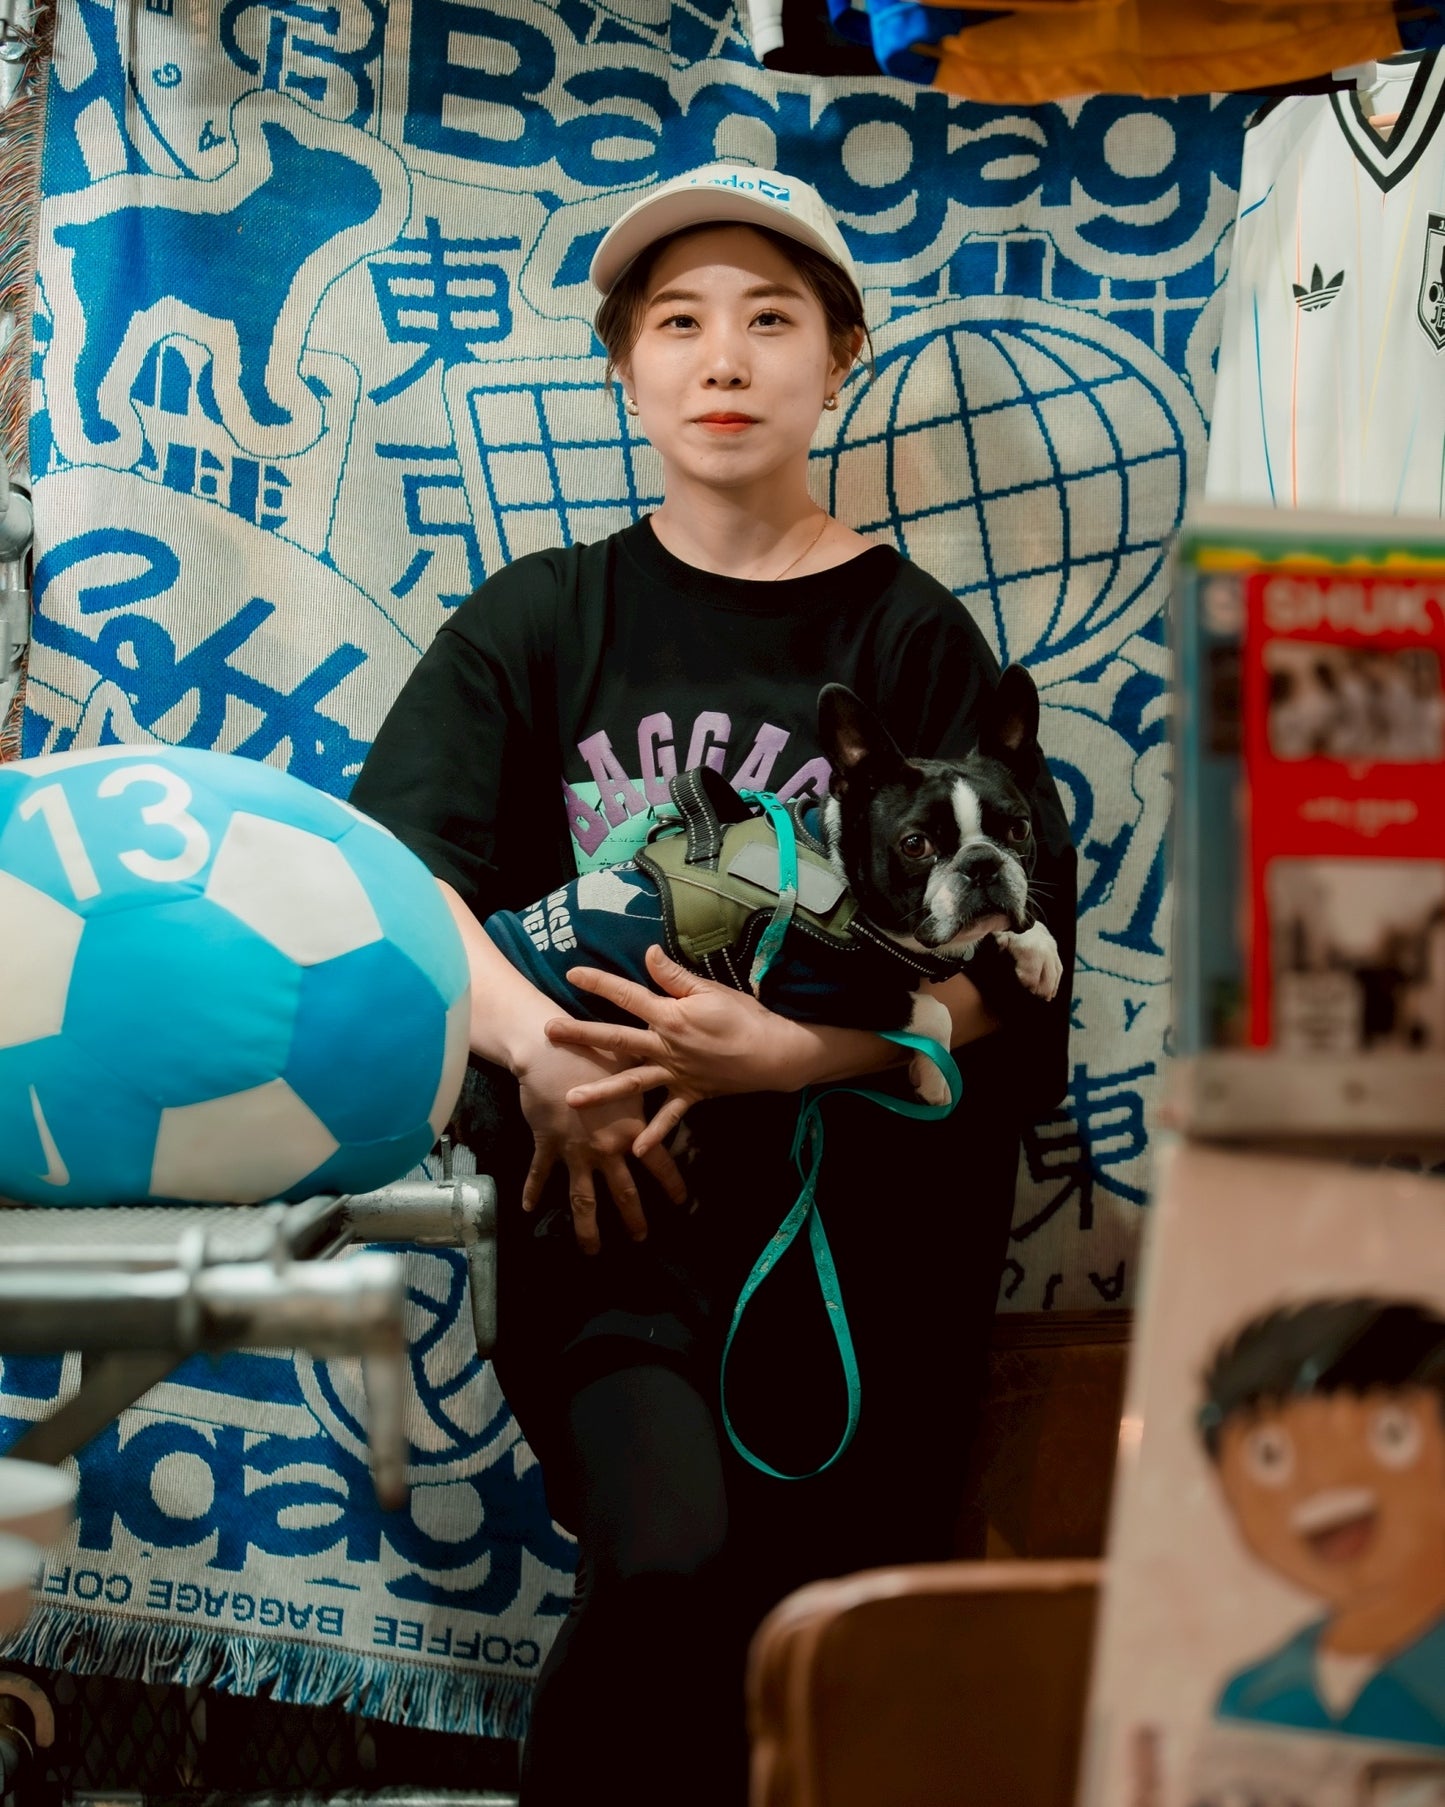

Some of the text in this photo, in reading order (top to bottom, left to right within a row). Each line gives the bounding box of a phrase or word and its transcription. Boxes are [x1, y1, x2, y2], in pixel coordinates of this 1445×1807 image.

[20, 763, 211, 902] 13
[145, 1579, 345, 1638] BAGGAGE
[372, 1614, 541, 1669] COFFEE
